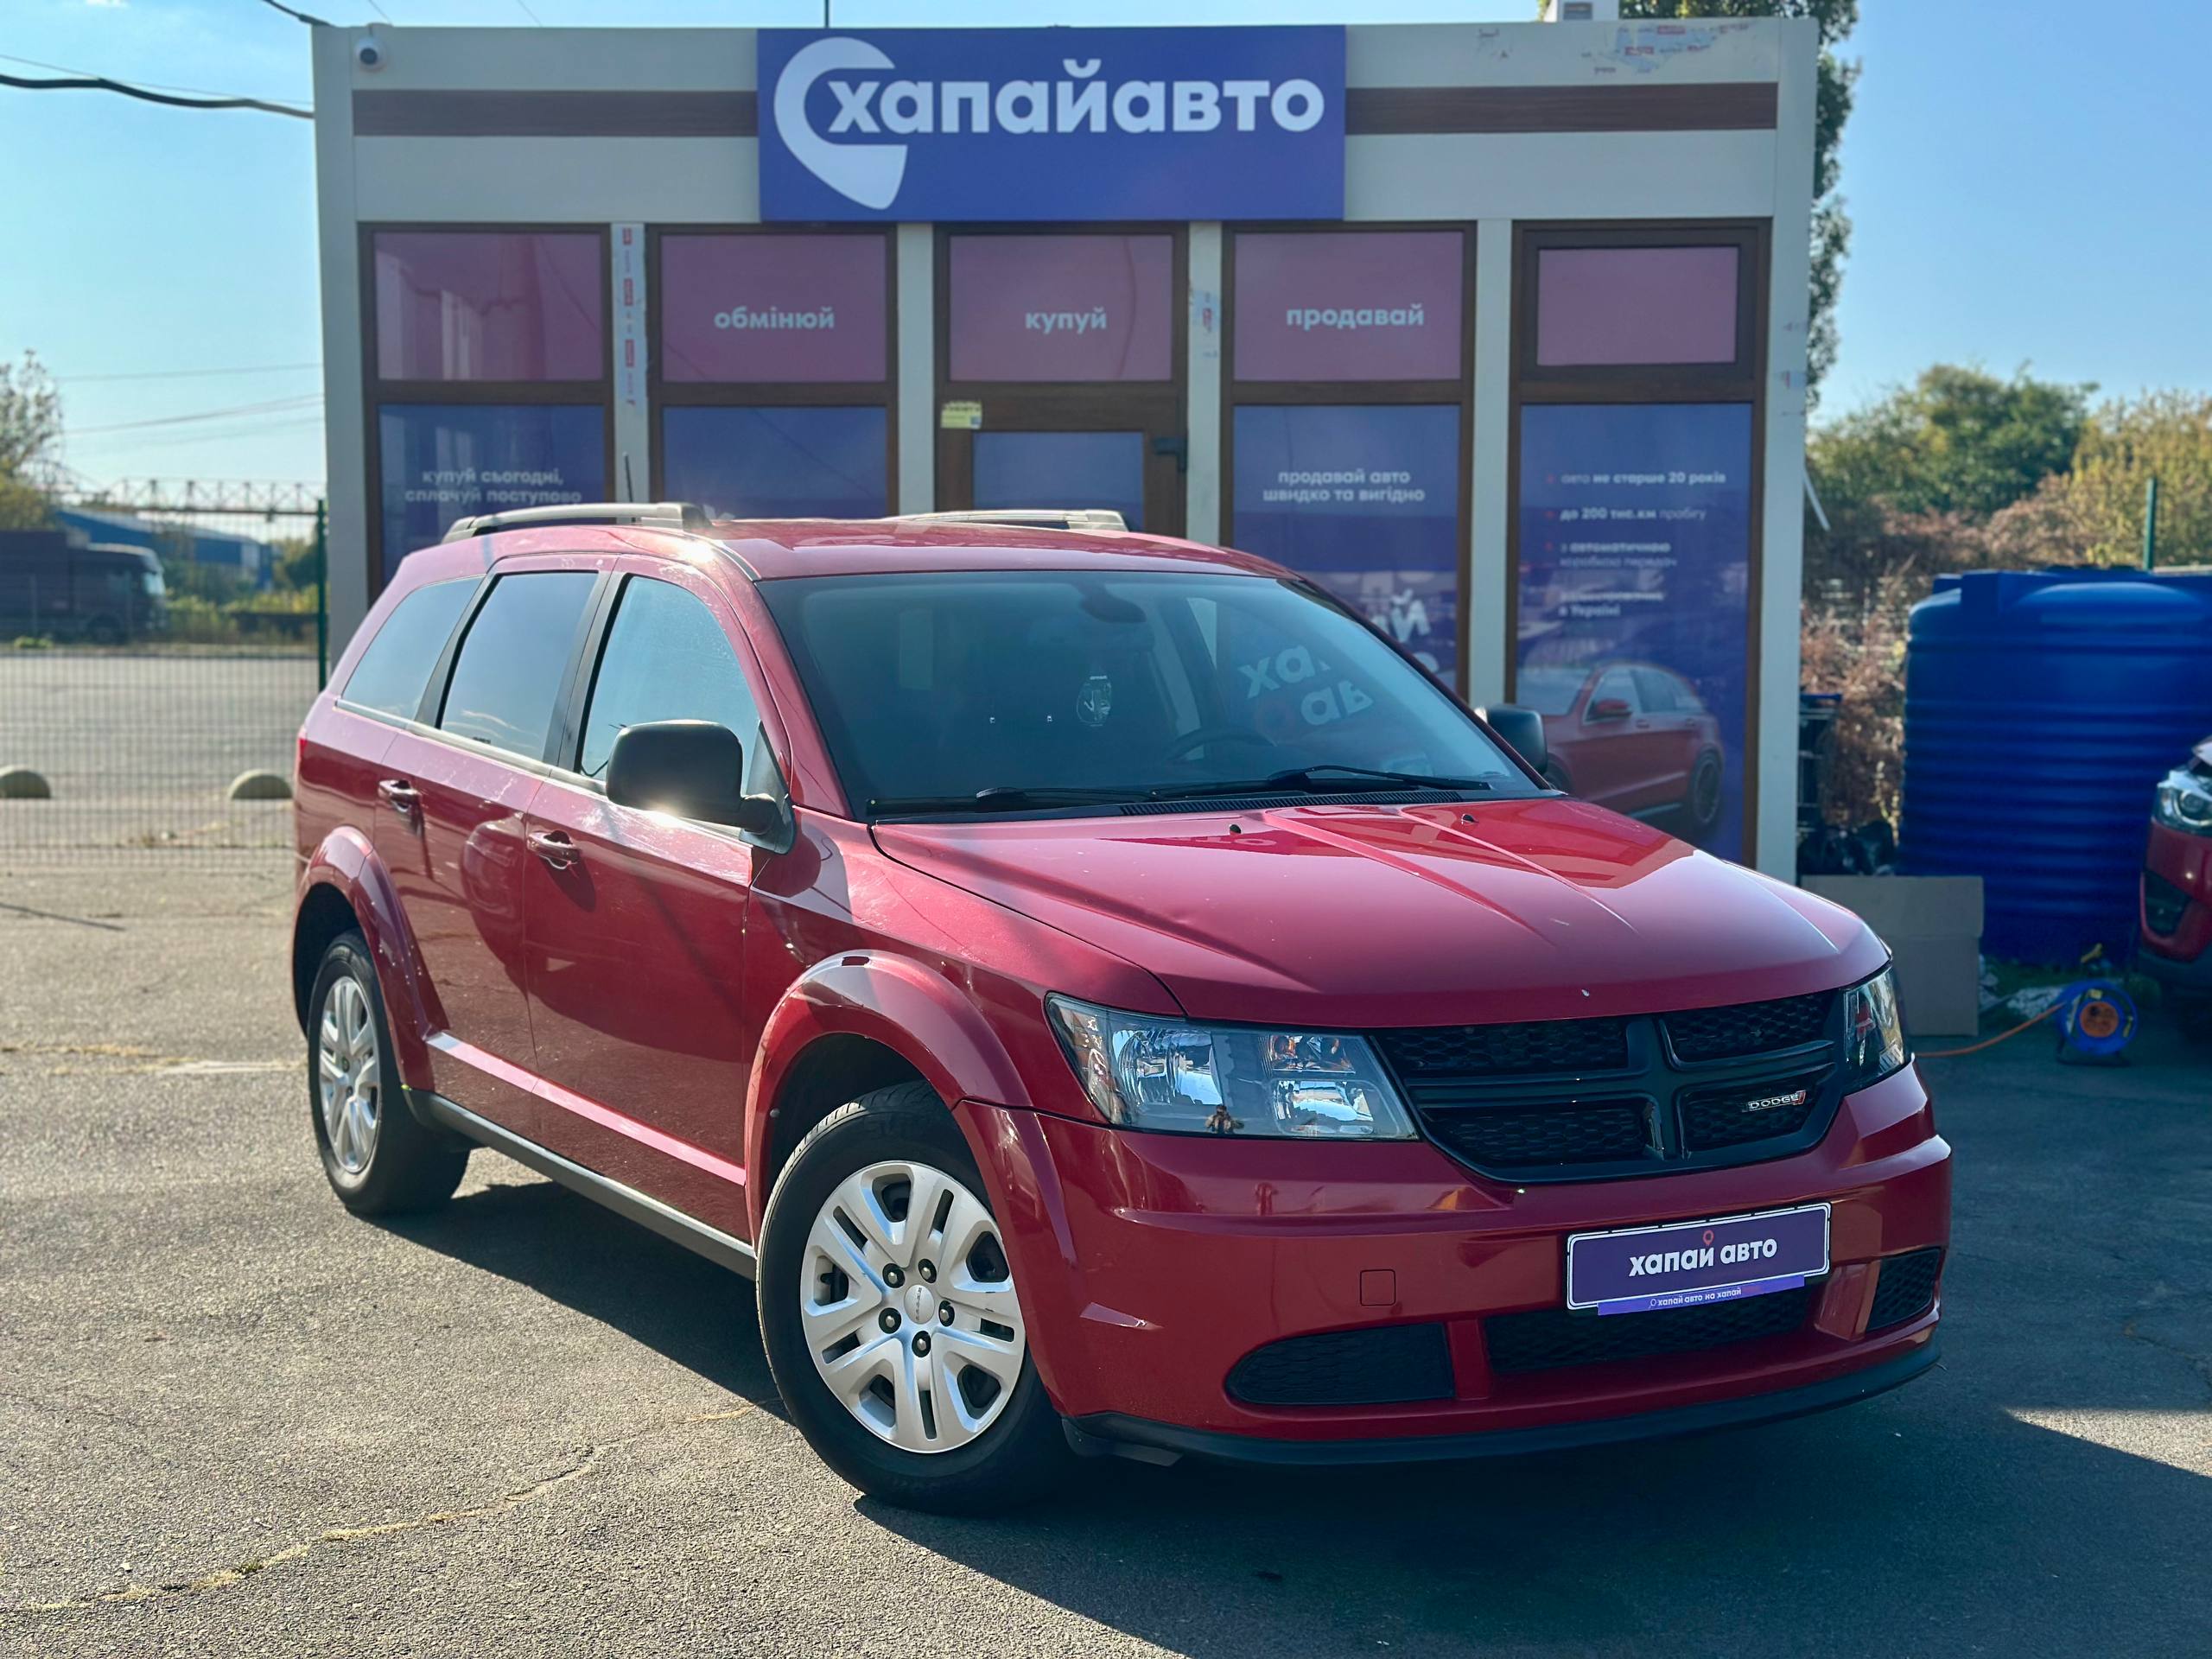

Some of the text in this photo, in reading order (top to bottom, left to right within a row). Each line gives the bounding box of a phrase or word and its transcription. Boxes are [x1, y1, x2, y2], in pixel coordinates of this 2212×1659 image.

[828, 58, 1325, 133] хапайавто
[714, 305, 835, 329] обмінюй
[1026, 306, 1106, 335] купуй
[1287, 303, 1424, 331] продавай
[423, 468, 475, 486] купуй
[1278, 468, 1411, 486] продавай авто
[1593, 474, 1609, 484] не
[1613, 474, 1666, 486] старше
[1668, 471, 1686, 484] 20
[1689, 471, 1726, 486] років
[405, 487, 582, 505] сплачуй поступово
[1263, 486, 1426, 503] швидко та вигідно
[1582, 506, 1607, 520] 200
[1749, 1093, 1799, 1109] DODGE
[1719, 1238, 1777, 1264] авто
[1658, 1287, 1741, 1306] хапай авто на хапай
